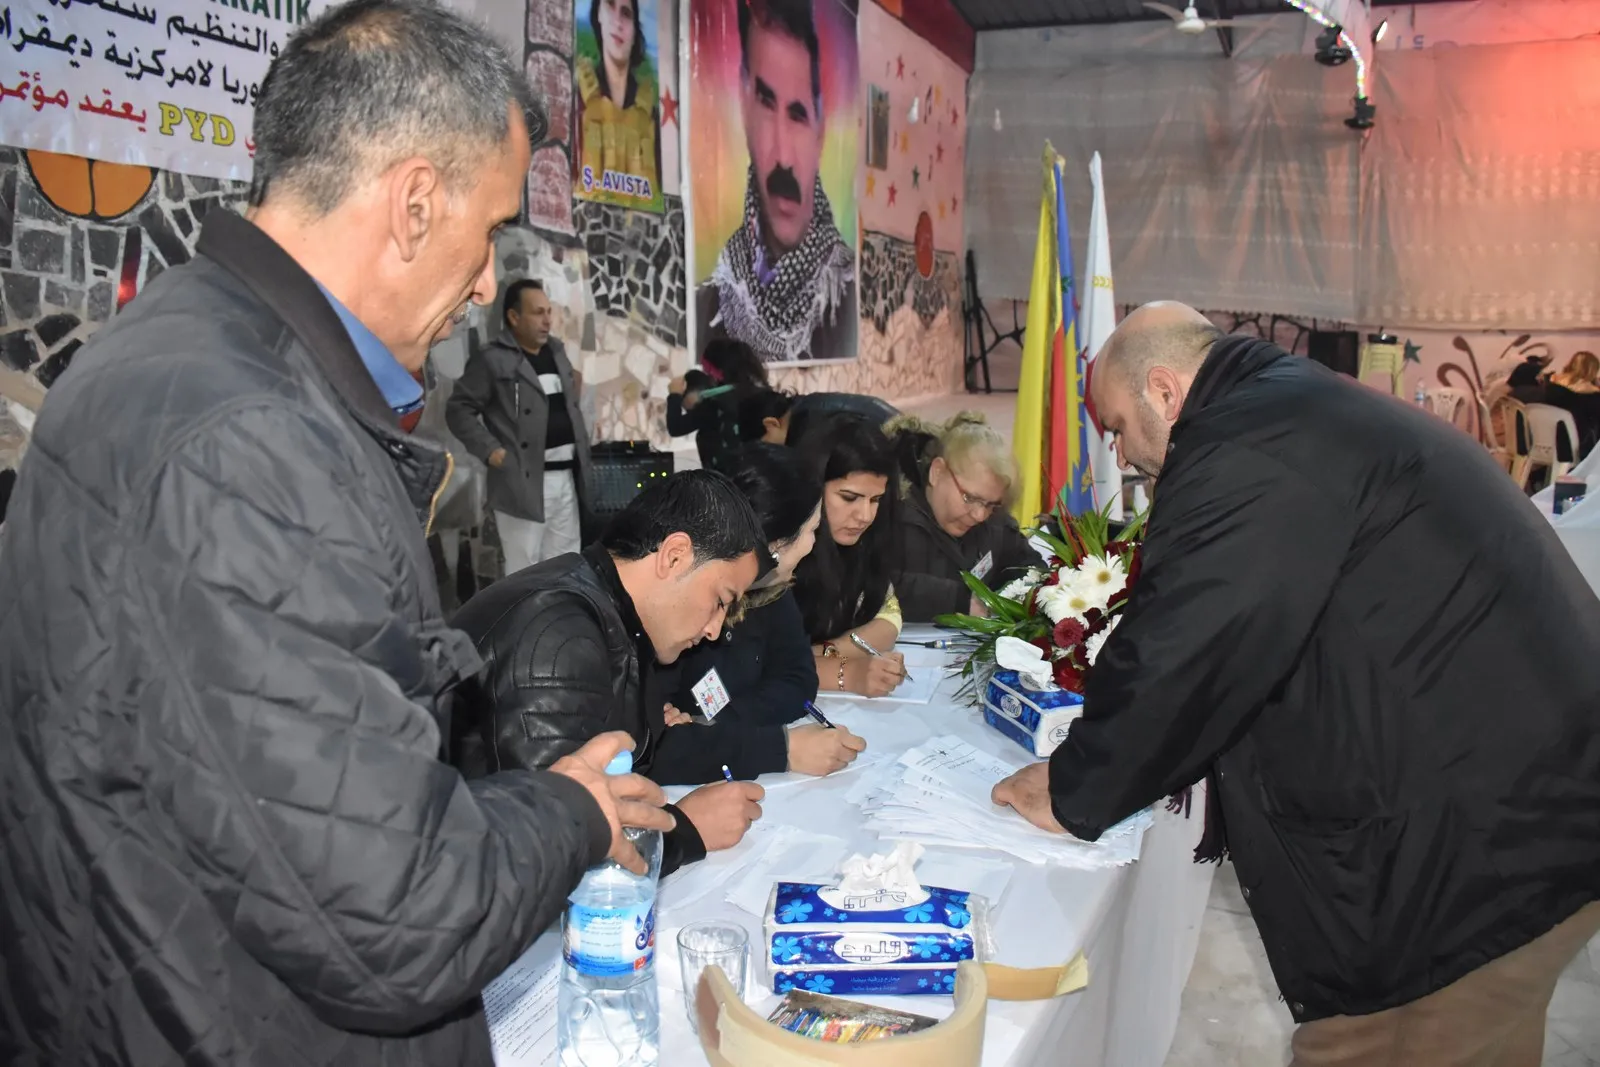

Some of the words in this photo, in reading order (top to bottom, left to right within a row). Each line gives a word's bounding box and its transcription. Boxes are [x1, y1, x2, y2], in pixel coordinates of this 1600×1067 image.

[103, 30, 213, 89] لامركزية
[78, 88, 147, 132] يعقد
[158, 101, 236, 147] PYD
[602, 170, 652, 198] AVISTA
